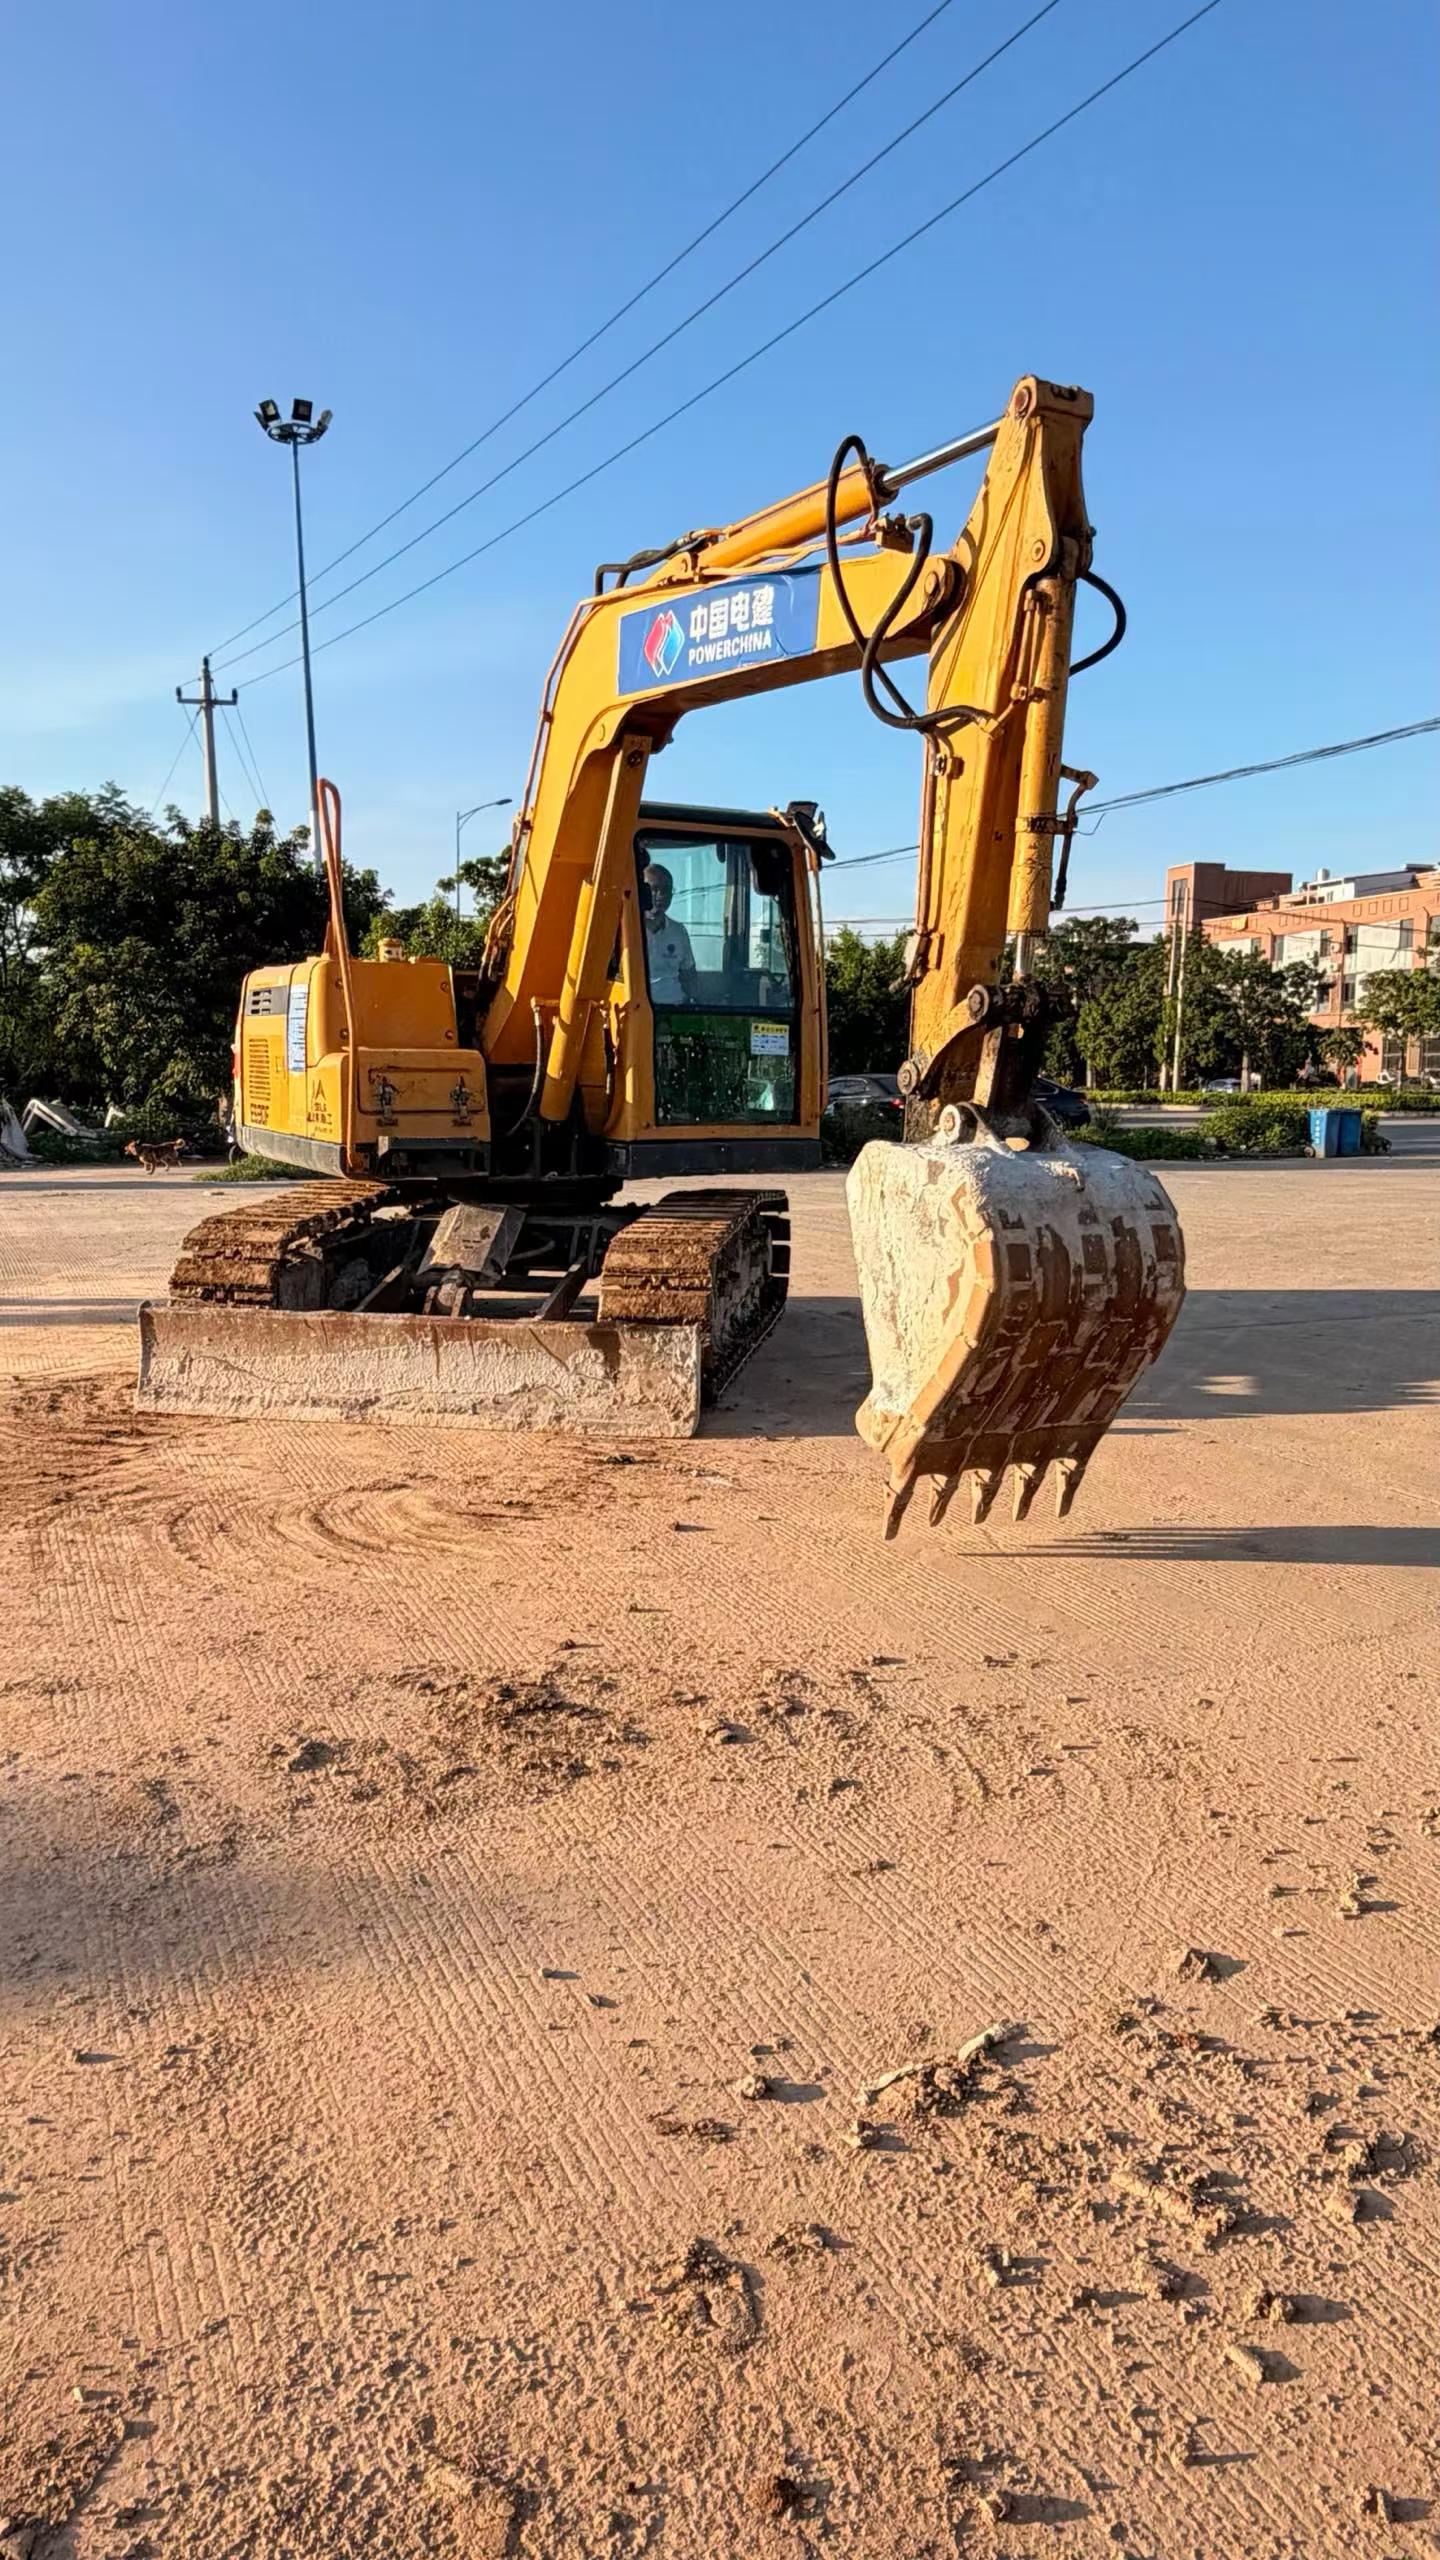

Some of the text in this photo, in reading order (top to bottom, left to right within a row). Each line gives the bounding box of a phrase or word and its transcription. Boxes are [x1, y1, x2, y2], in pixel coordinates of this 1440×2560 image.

[690, 585, 775, 643] 中国电建
[688, 629, 772, 666] POWERCHINA
